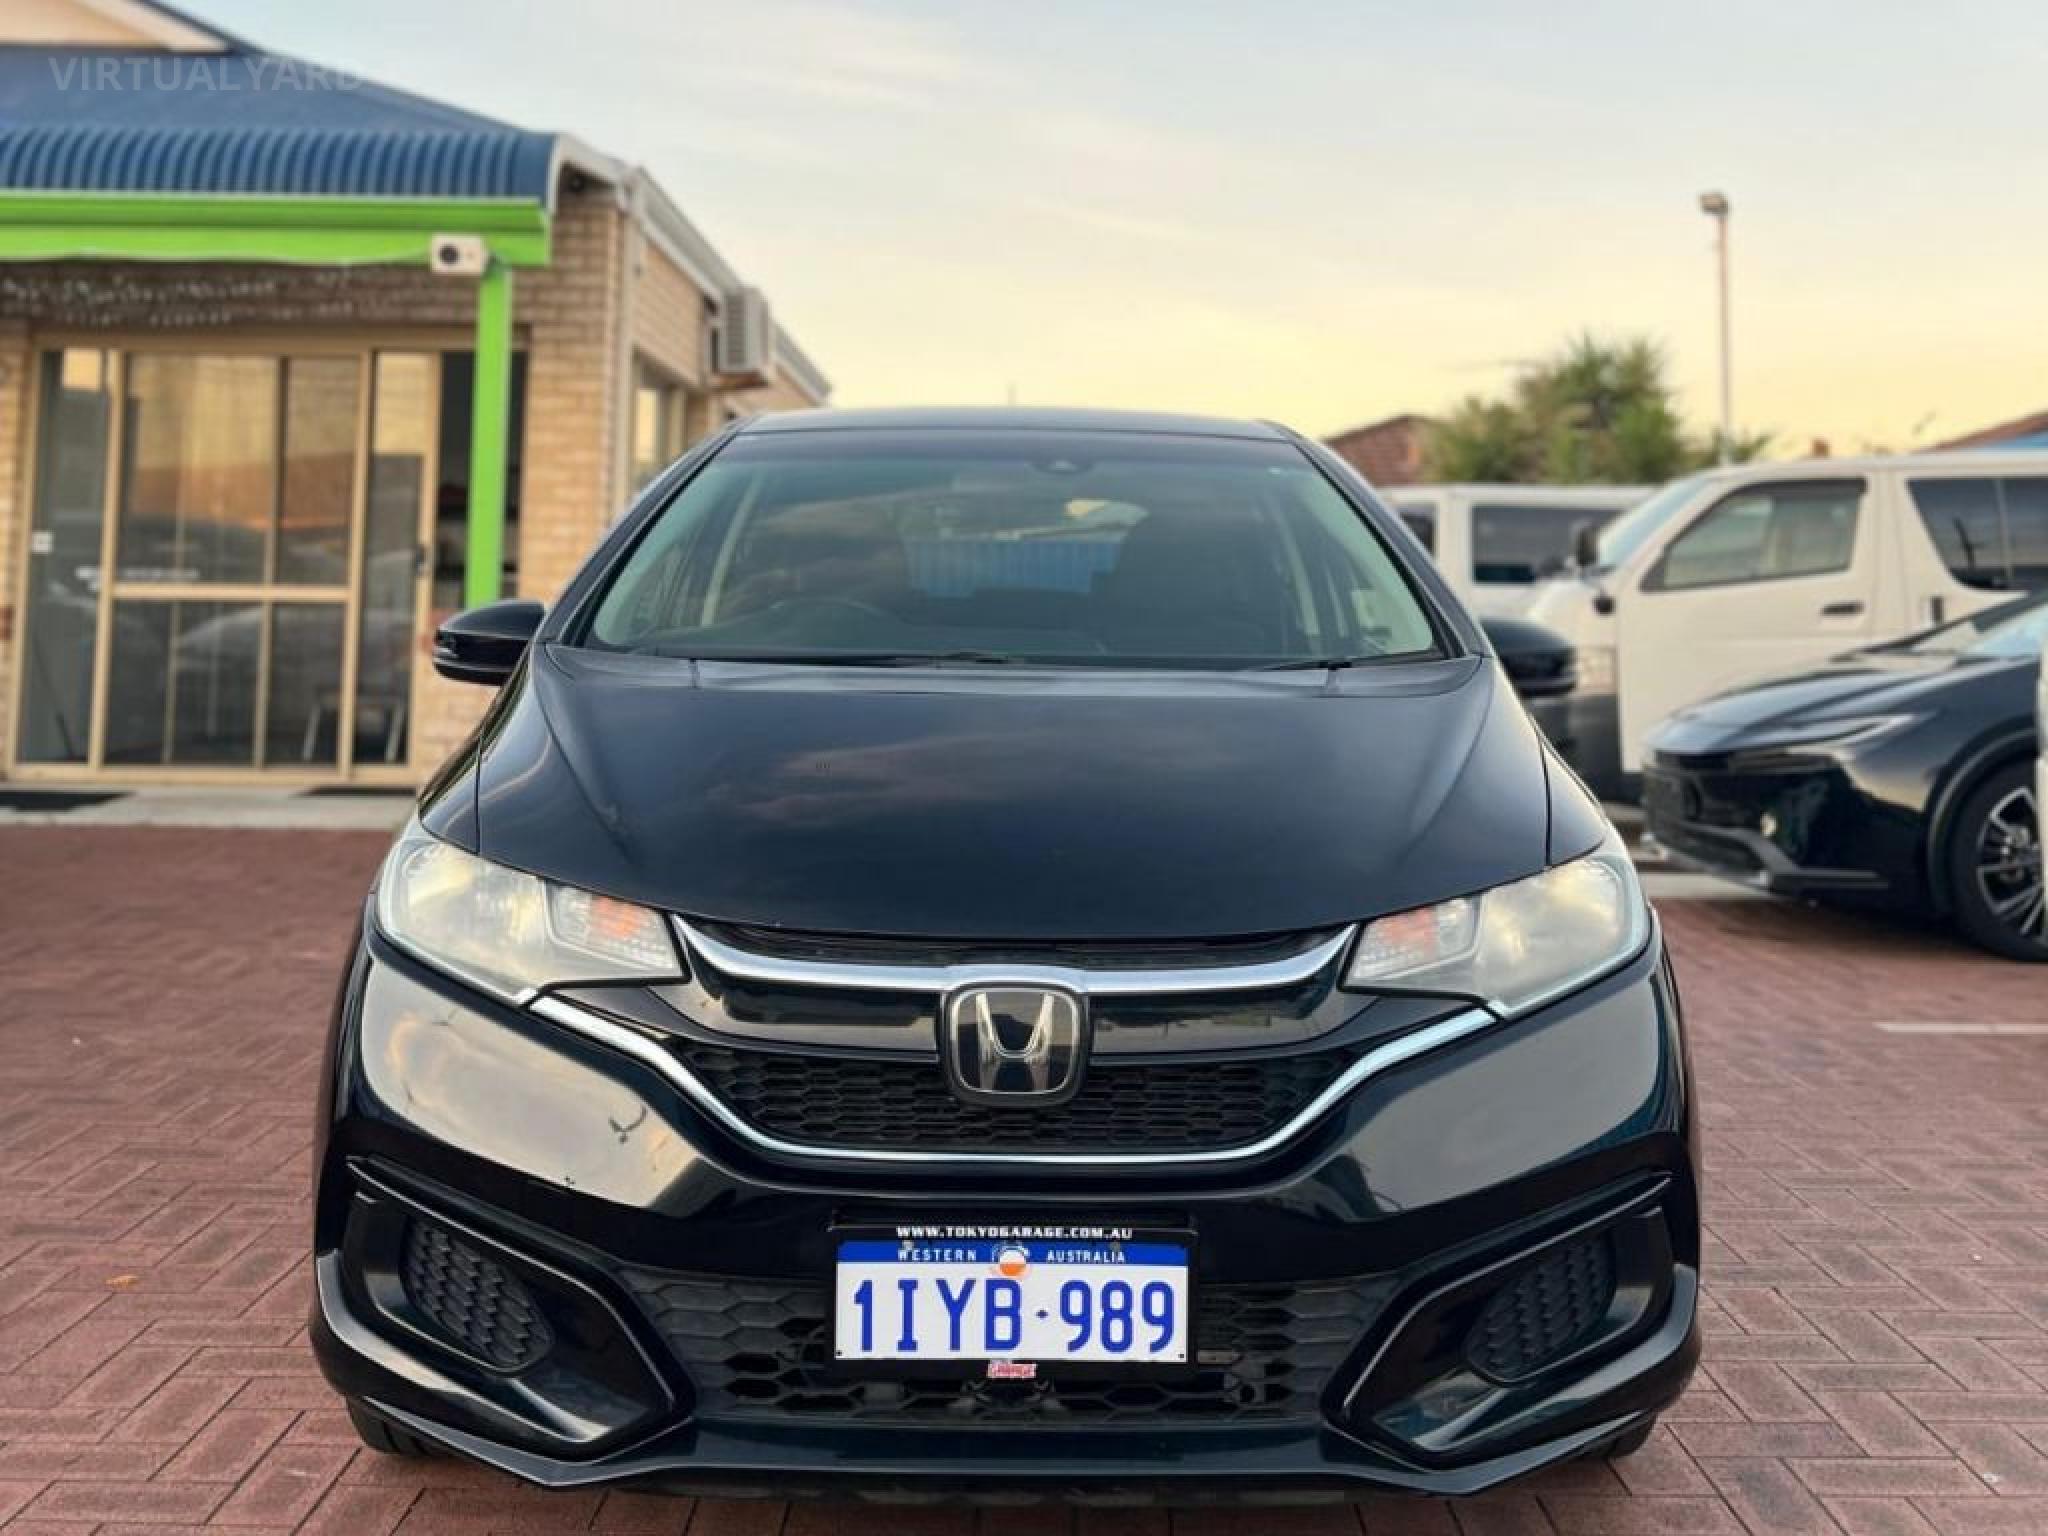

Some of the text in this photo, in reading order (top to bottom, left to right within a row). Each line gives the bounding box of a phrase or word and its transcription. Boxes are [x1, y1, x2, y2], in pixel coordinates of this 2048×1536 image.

[896, 1226, 1133, 1239] WWW.TOKYOGARAGE.COM.AU
[898, 1249, 1125, 1263] WESTERN AUSTRALIA
